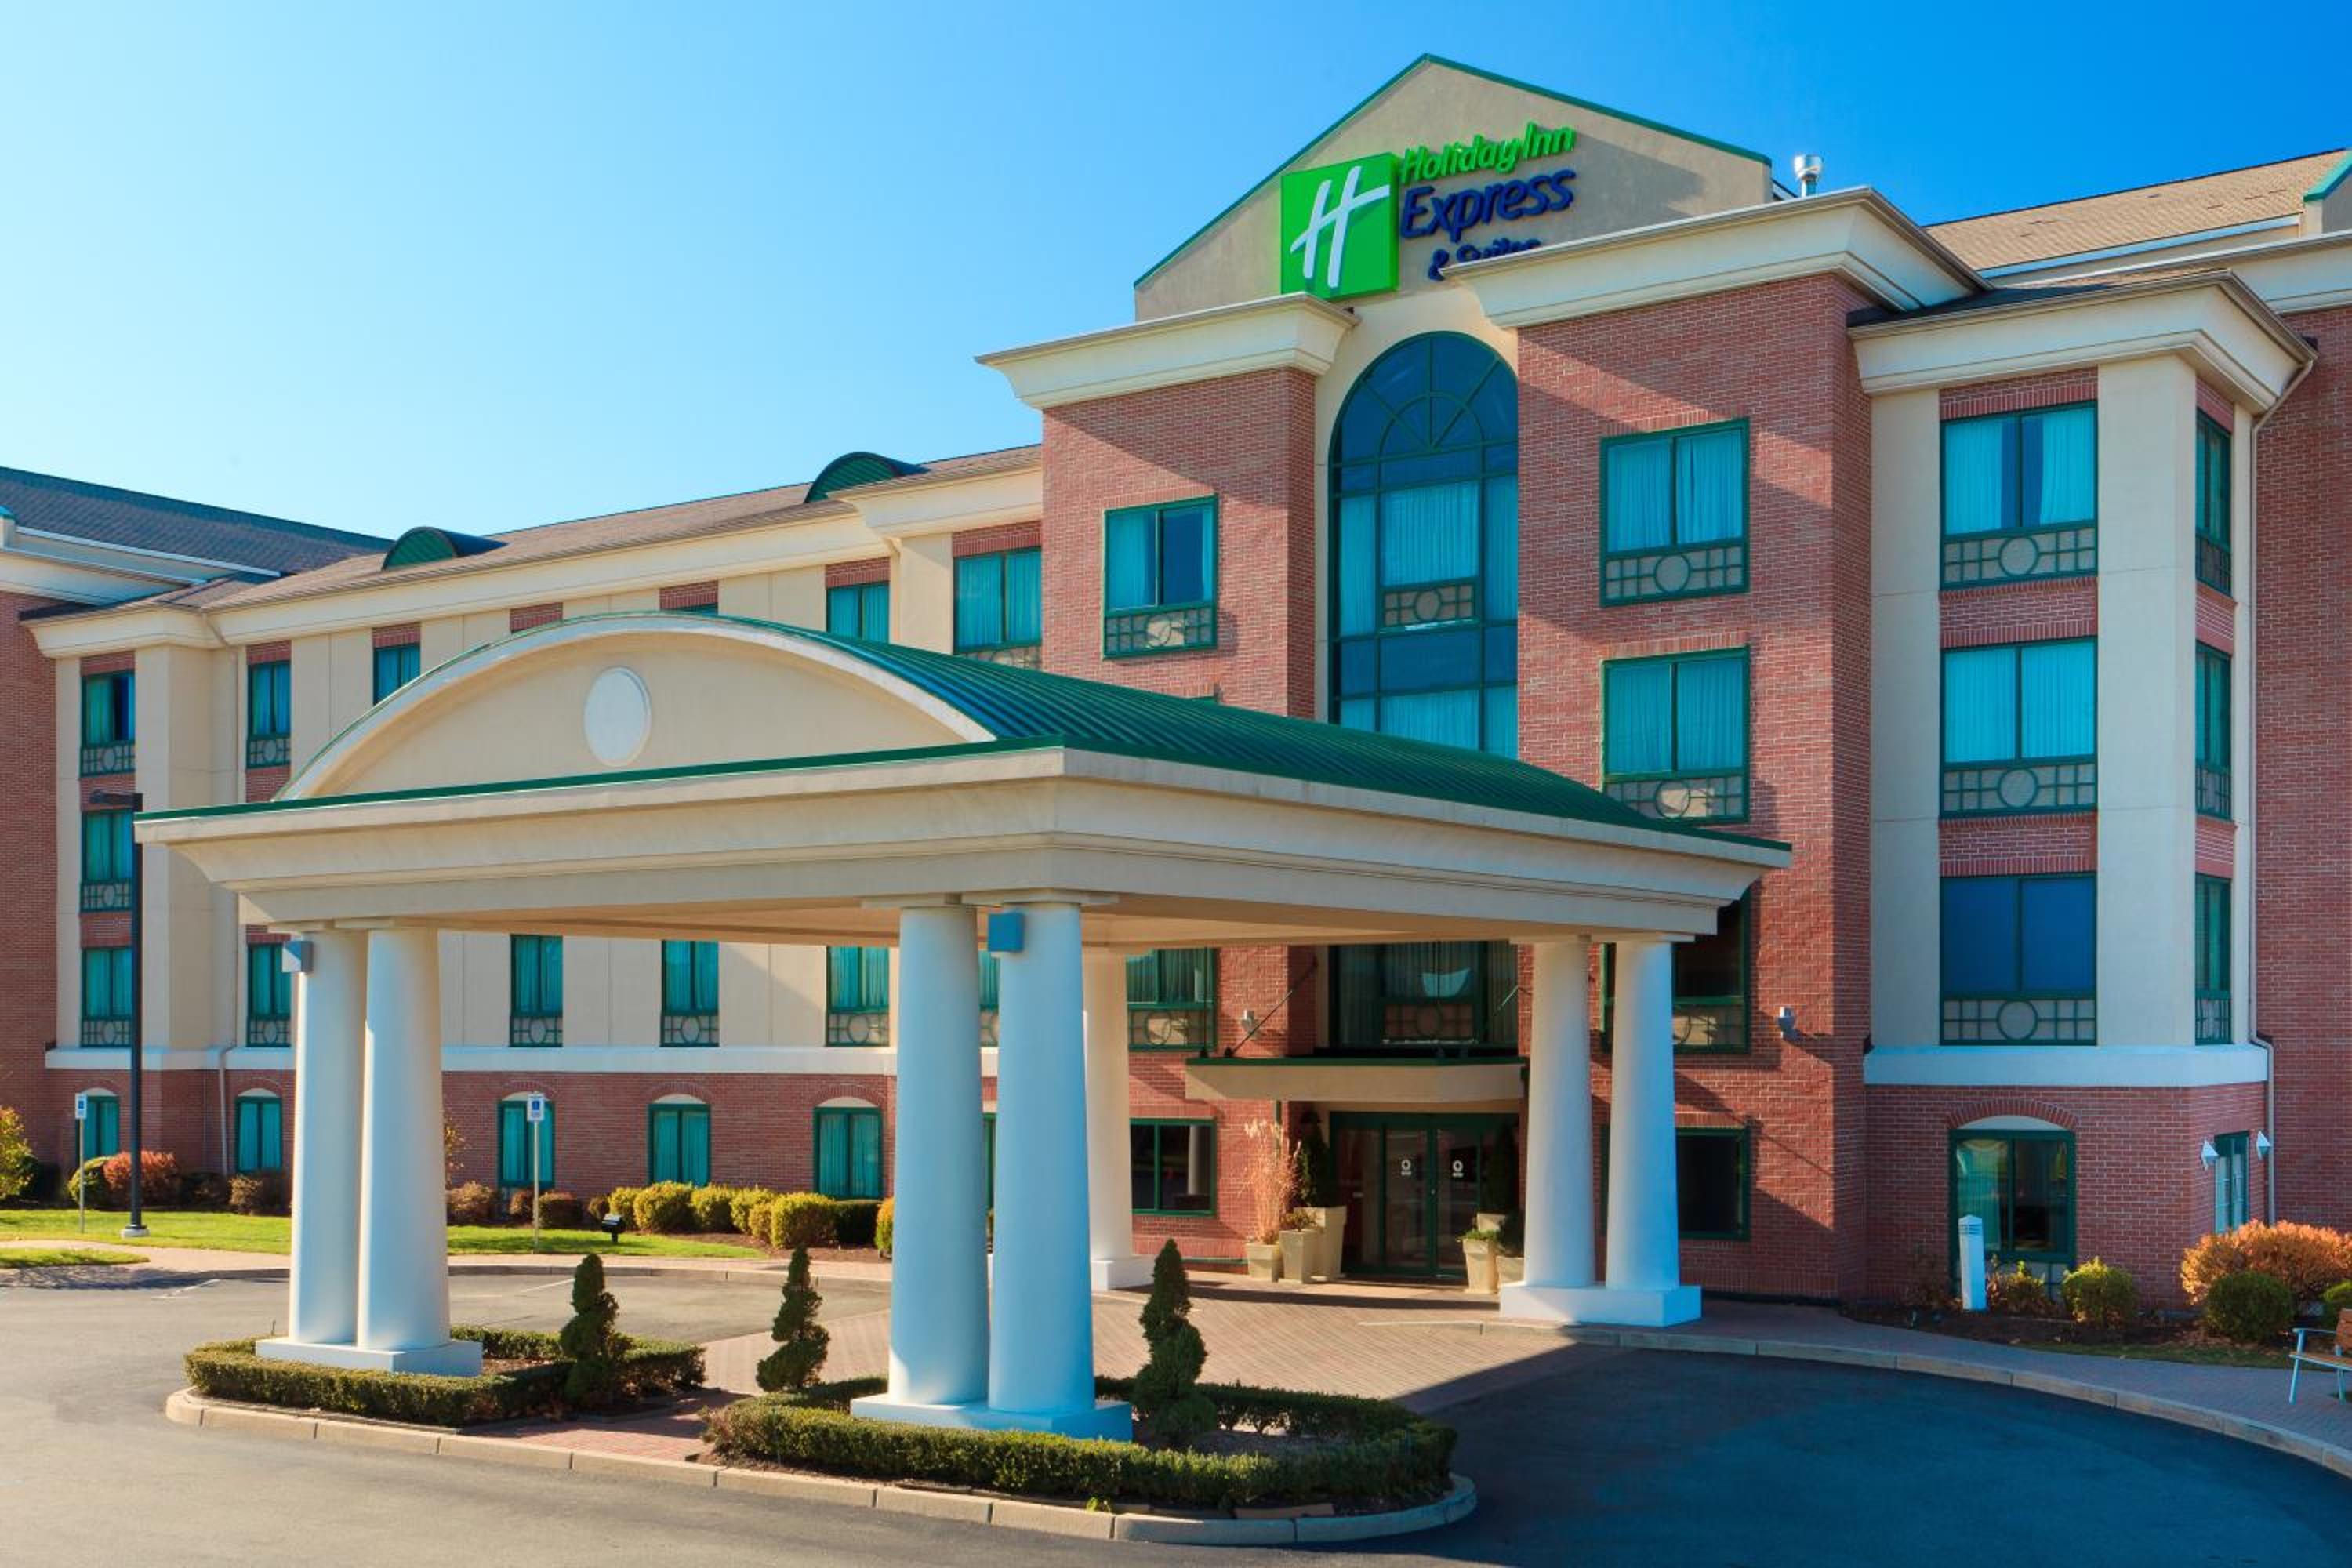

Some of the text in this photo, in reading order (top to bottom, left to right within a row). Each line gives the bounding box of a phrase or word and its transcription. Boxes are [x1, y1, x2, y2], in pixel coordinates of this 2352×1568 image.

[1401, 122, 1577, 185] Holiday Inn
[1401, 169, 1576, 243] Express
[1428, 249, 1449, 281] &
